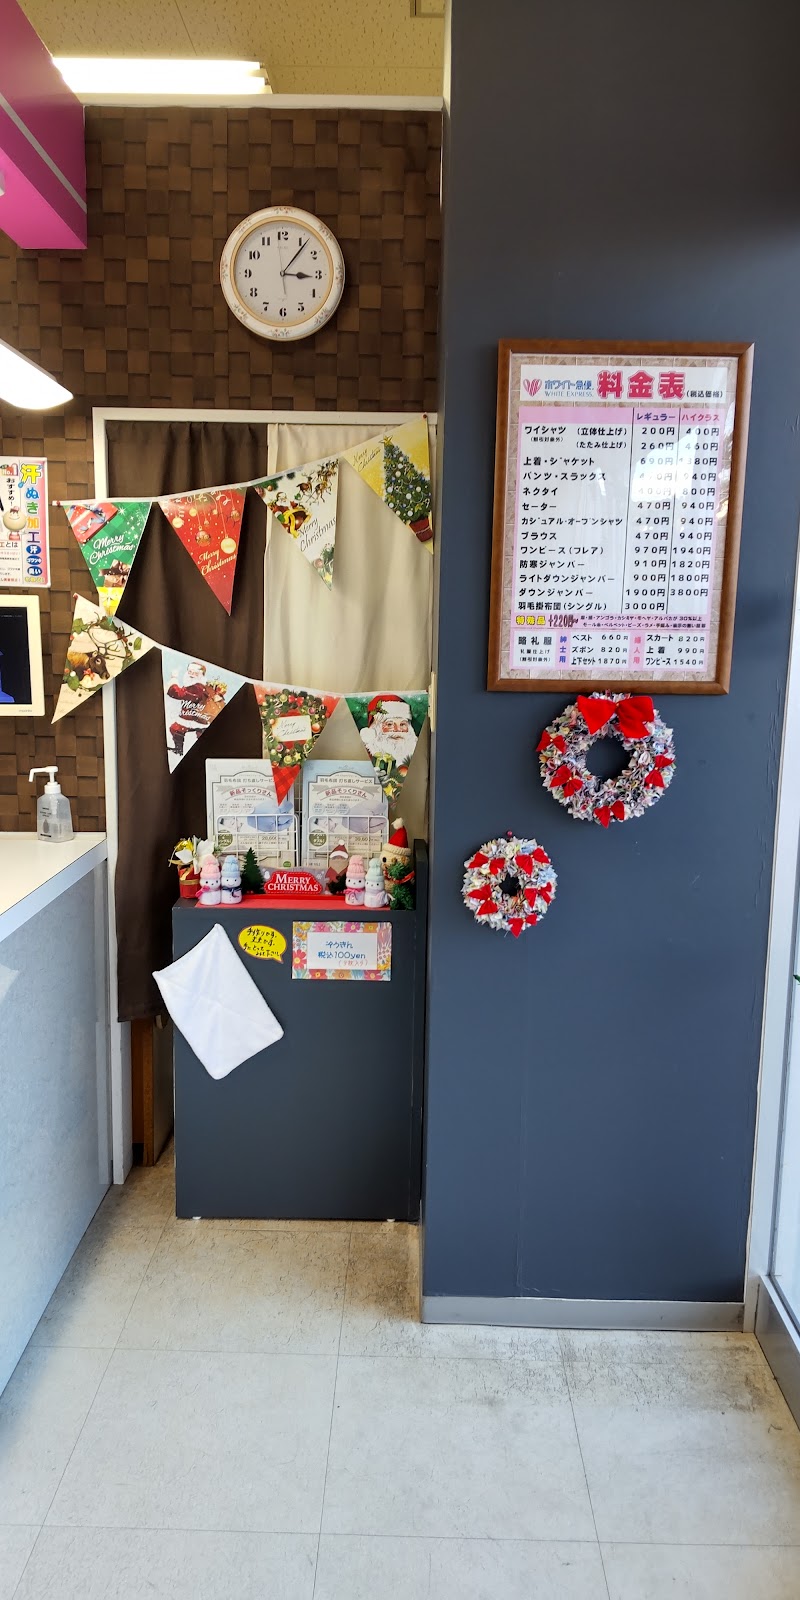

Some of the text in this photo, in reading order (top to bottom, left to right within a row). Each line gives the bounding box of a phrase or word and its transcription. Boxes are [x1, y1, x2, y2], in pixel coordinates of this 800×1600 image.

[277, 231, 288, 240] 12
[262, 236, 270, 246] 11
[248, 250, 260, 260] 10
[310, 250, 318, 260] 2
[244, 268, 252, 278] 9
[315, 270, 322, 280] 3
[250, 288, 258, 297] 8
[262, 301, 270, 312] 7
[298, 302, 304, 312] 5
[279, 308, 286, 317] 6
[596, 370, 687, 401] 料金表
[636, 413, 720, 422] レギュラー ハイクラス
[524, 426, 566, 435] ワイシャツ
[578, 427, 628, 436] (立体仕上げ)
[642, 426, 676, 436] 200円
[576, 441, 627, 450] (たたみ仕上げ)
[640, 442, 674, 451] 260円
[522, 487, 559, 496] ネクタイ
[20, 463, 42, 544] 汗ぬき加工
[522, 502, 716, 511] セーター 470円 940円
[636, 516, 670, 526] 470円
[680, 516, 714, 526] 940円
[300, 518, 336, 552] Christmas
[521, 532, 713, 542] ブラウス 470円 940円
[93, 533, 125, 550] Merry
[90, 541, 136, 566] Christmas
[634, 546, 668, 556] 970円
[672, 546, 712, 556] 1940円
[197, 549, 220, 566] Merry
[201, 553, 237, 577] Christmas
[634, 560, 668, 569] 910円
[672, 560, 710, 570] 1820円
[633, 574, 666, 583] 900円
[670, 574, 709, 584] 1800円
[626, 588, 666, 598] 1900円
[670, 588, 708, 598] 3800円
[624, 602, 665, 612] 3000円
[518, 636, 552, 646] 略礼服
[572, 634, 629, 642] ベスト 660円
[646, 634, 674, 642] スカート
[572, 646, 628, 654] ズボン 820円
[646, 646, 666, 654] 上着
[598, 658, 627, 666] 1870円
[673, 658, 704, 666] 1540円
[275, 874, 310, 884] MERRY
[267, 884, 318, 892] CHRISTMAS
